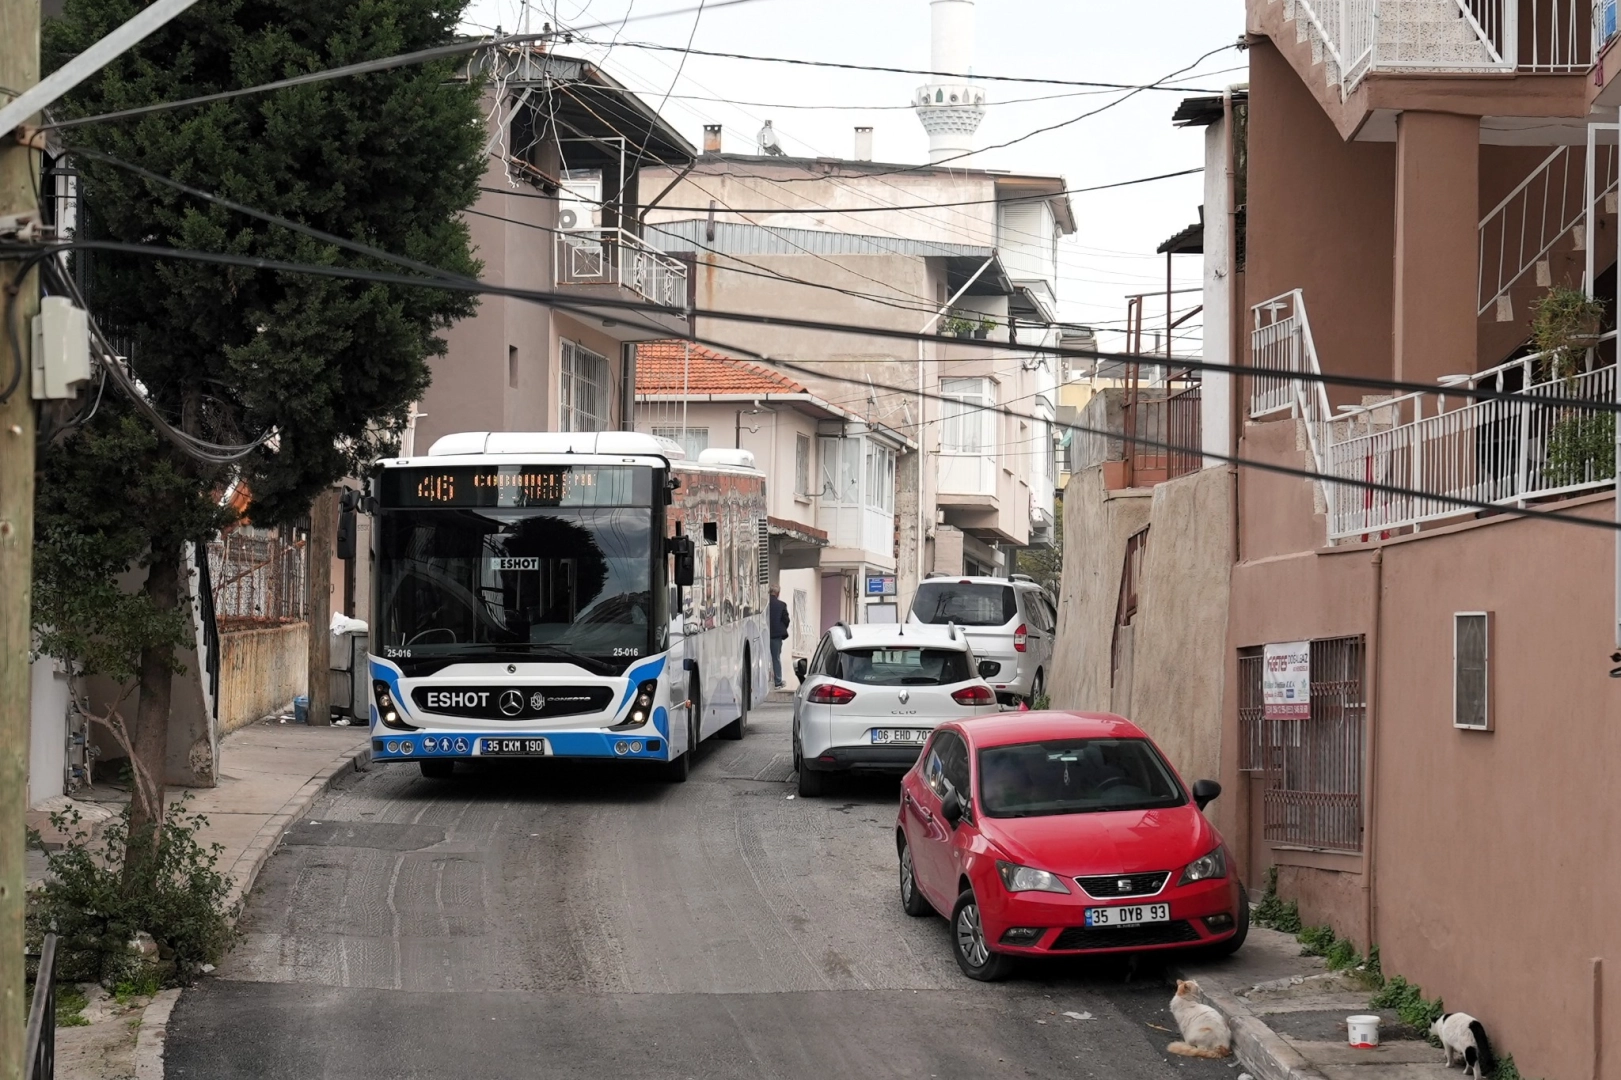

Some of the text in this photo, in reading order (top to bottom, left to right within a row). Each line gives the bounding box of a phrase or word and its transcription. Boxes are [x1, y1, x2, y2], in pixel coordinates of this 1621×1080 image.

[418, 474, 454, 501] 46
[500, 558, 537, 569] ESHOT
[387, 649, 412, 658] 25-016
[613, 647, 639, 656] 25-016
[427, 692, 490, 708] ESHOT
[877, 730, 889, 740] 06
[487, 740, 542, 752] 35 CKM 190
[1092, 905, 1166, 924] 35 DYB 93
